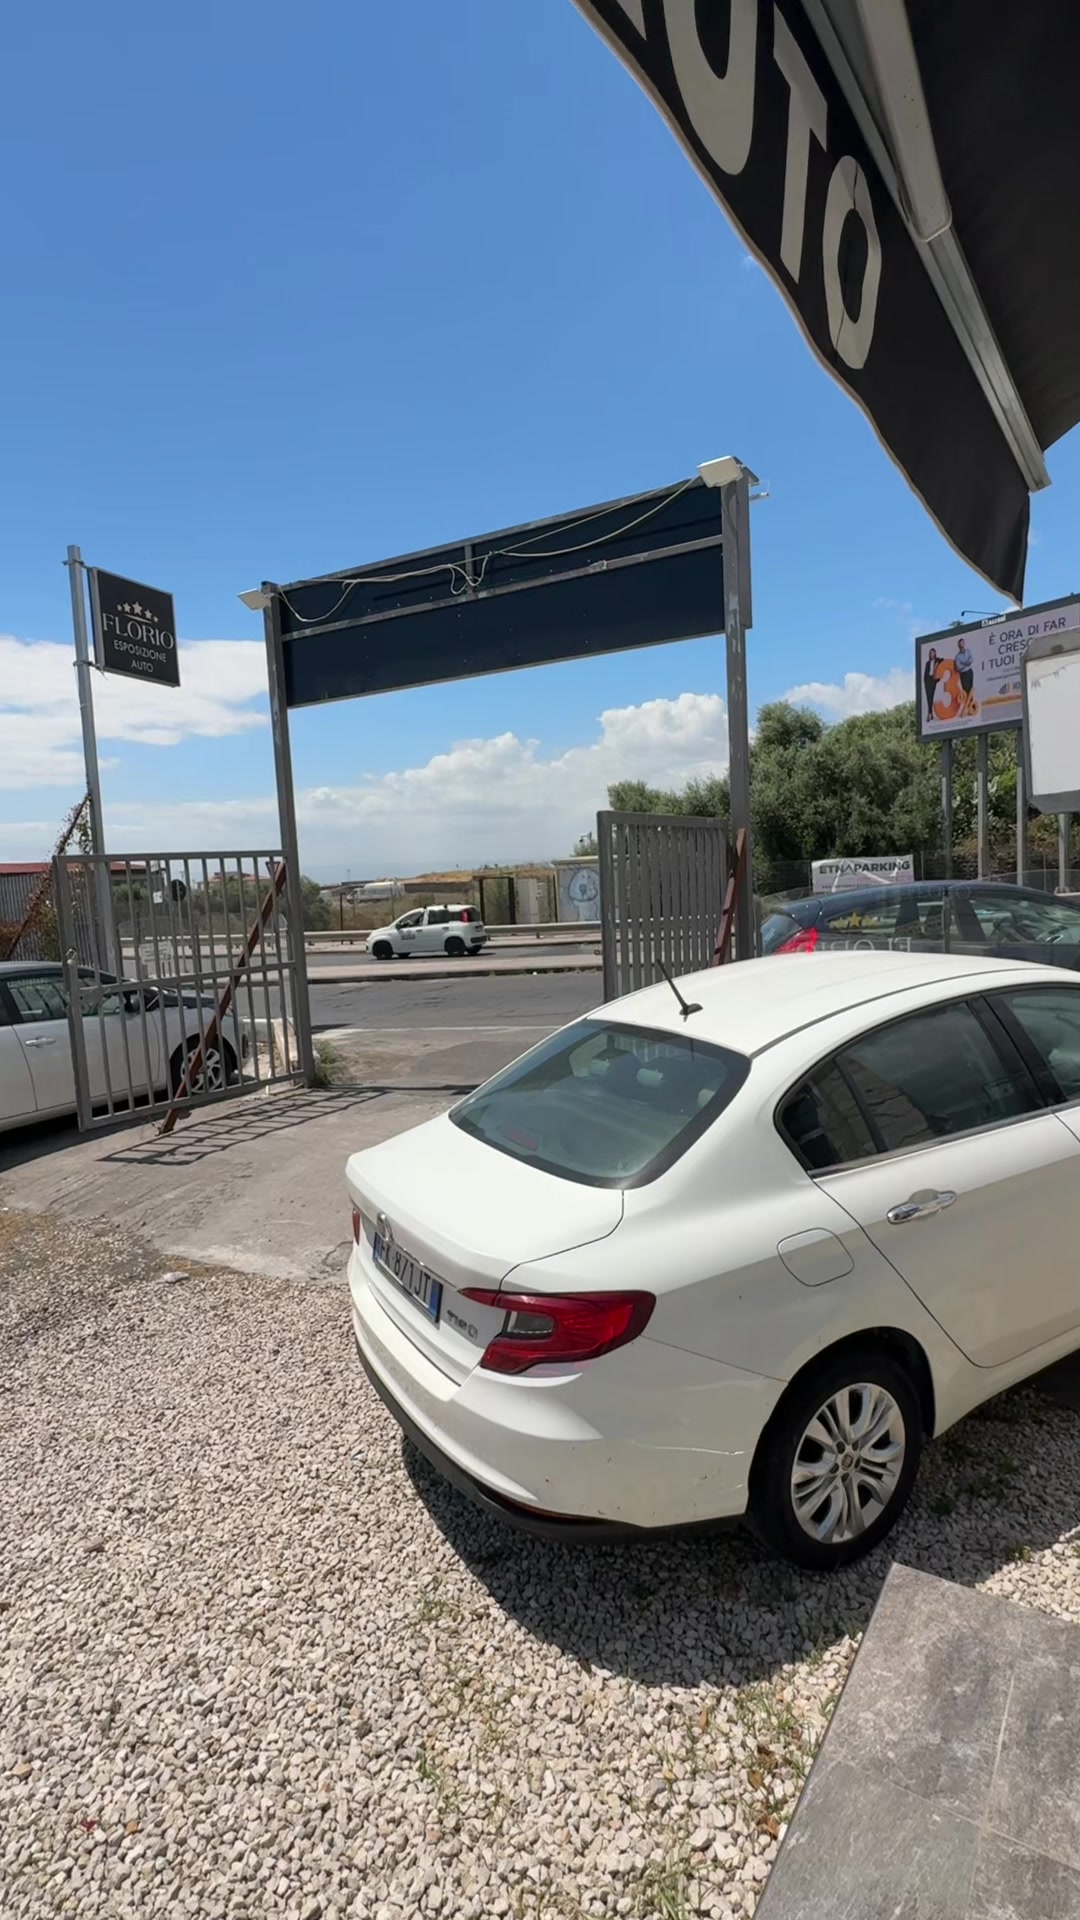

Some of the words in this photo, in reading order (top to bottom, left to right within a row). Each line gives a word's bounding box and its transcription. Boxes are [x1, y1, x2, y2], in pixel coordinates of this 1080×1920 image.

[102, 612, 174, 650] FLORIO
[988, 632, 996, 645] È
[999, 629, 1023, 643] ORA
[1027, 624, 1039, 636] DI
[1043, 617, 1066, 632] FAR
[113, 639, 167, 663] ESPOSIZIONE
[981, 661, 985, 671] I
[988, 655, 1015, 669] TUOI
[131, 660, 154, 673] AUTO
